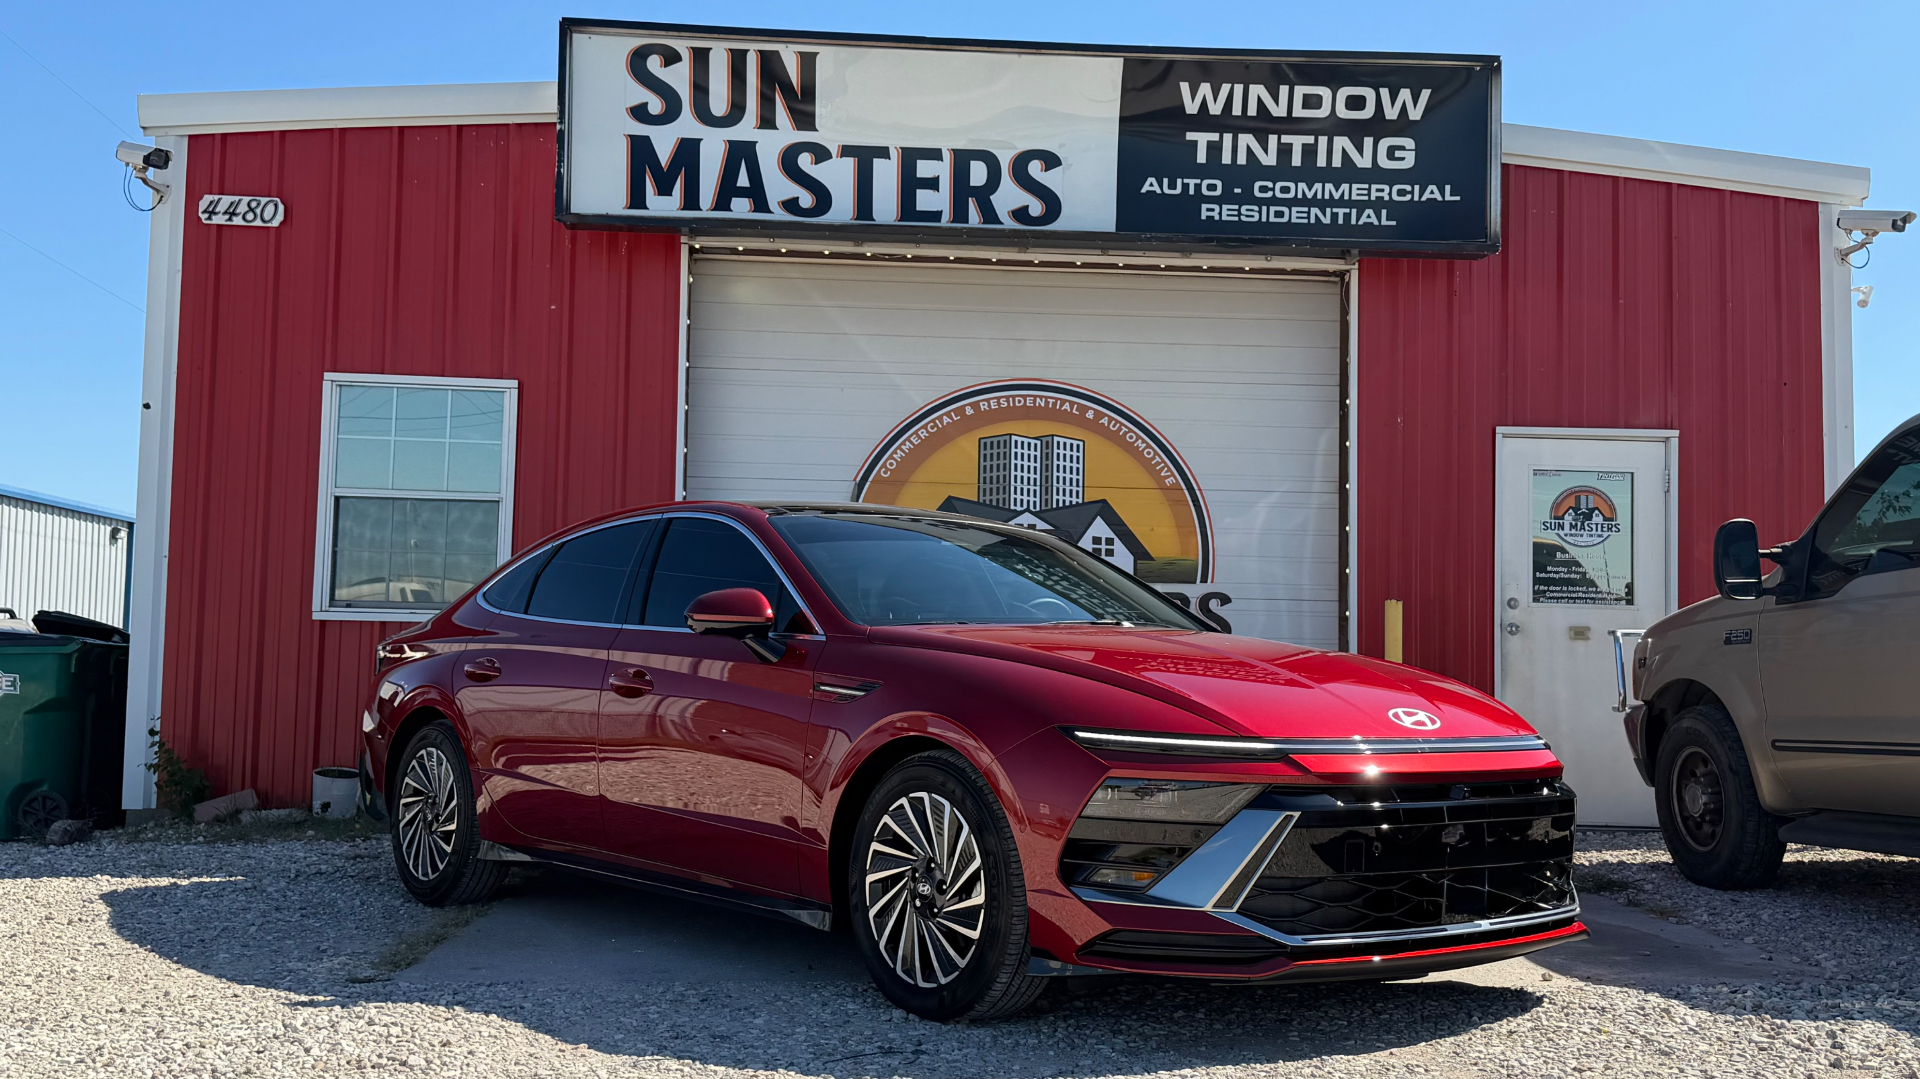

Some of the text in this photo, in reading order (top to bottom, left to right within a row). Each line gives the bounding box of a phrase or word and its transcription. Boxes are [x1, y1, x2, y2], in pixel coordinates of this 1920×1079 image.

[625, 43, 820, 132] SUN
[1179, 81, 1432, 121] WINDOW
[1185, 131, 1416, 170] TINTING
[623, 134, 1063, 227] MASTERS
[1140, 177, 1223, 196] AUTO
[1253, 180, 1461, 202] COMMERCIAL
[201, 196, 279, 224] 4480
[1200, 204, 1397, 226] RESIDENTIAL
[880, 396, 1177, 487] COMMERCIAL & RESIDENTIAL & AUTOMOTIVE
[1542, 520, 1621, 533] SUN MASTERS
[1546, 565, 1568, 573] Monday
